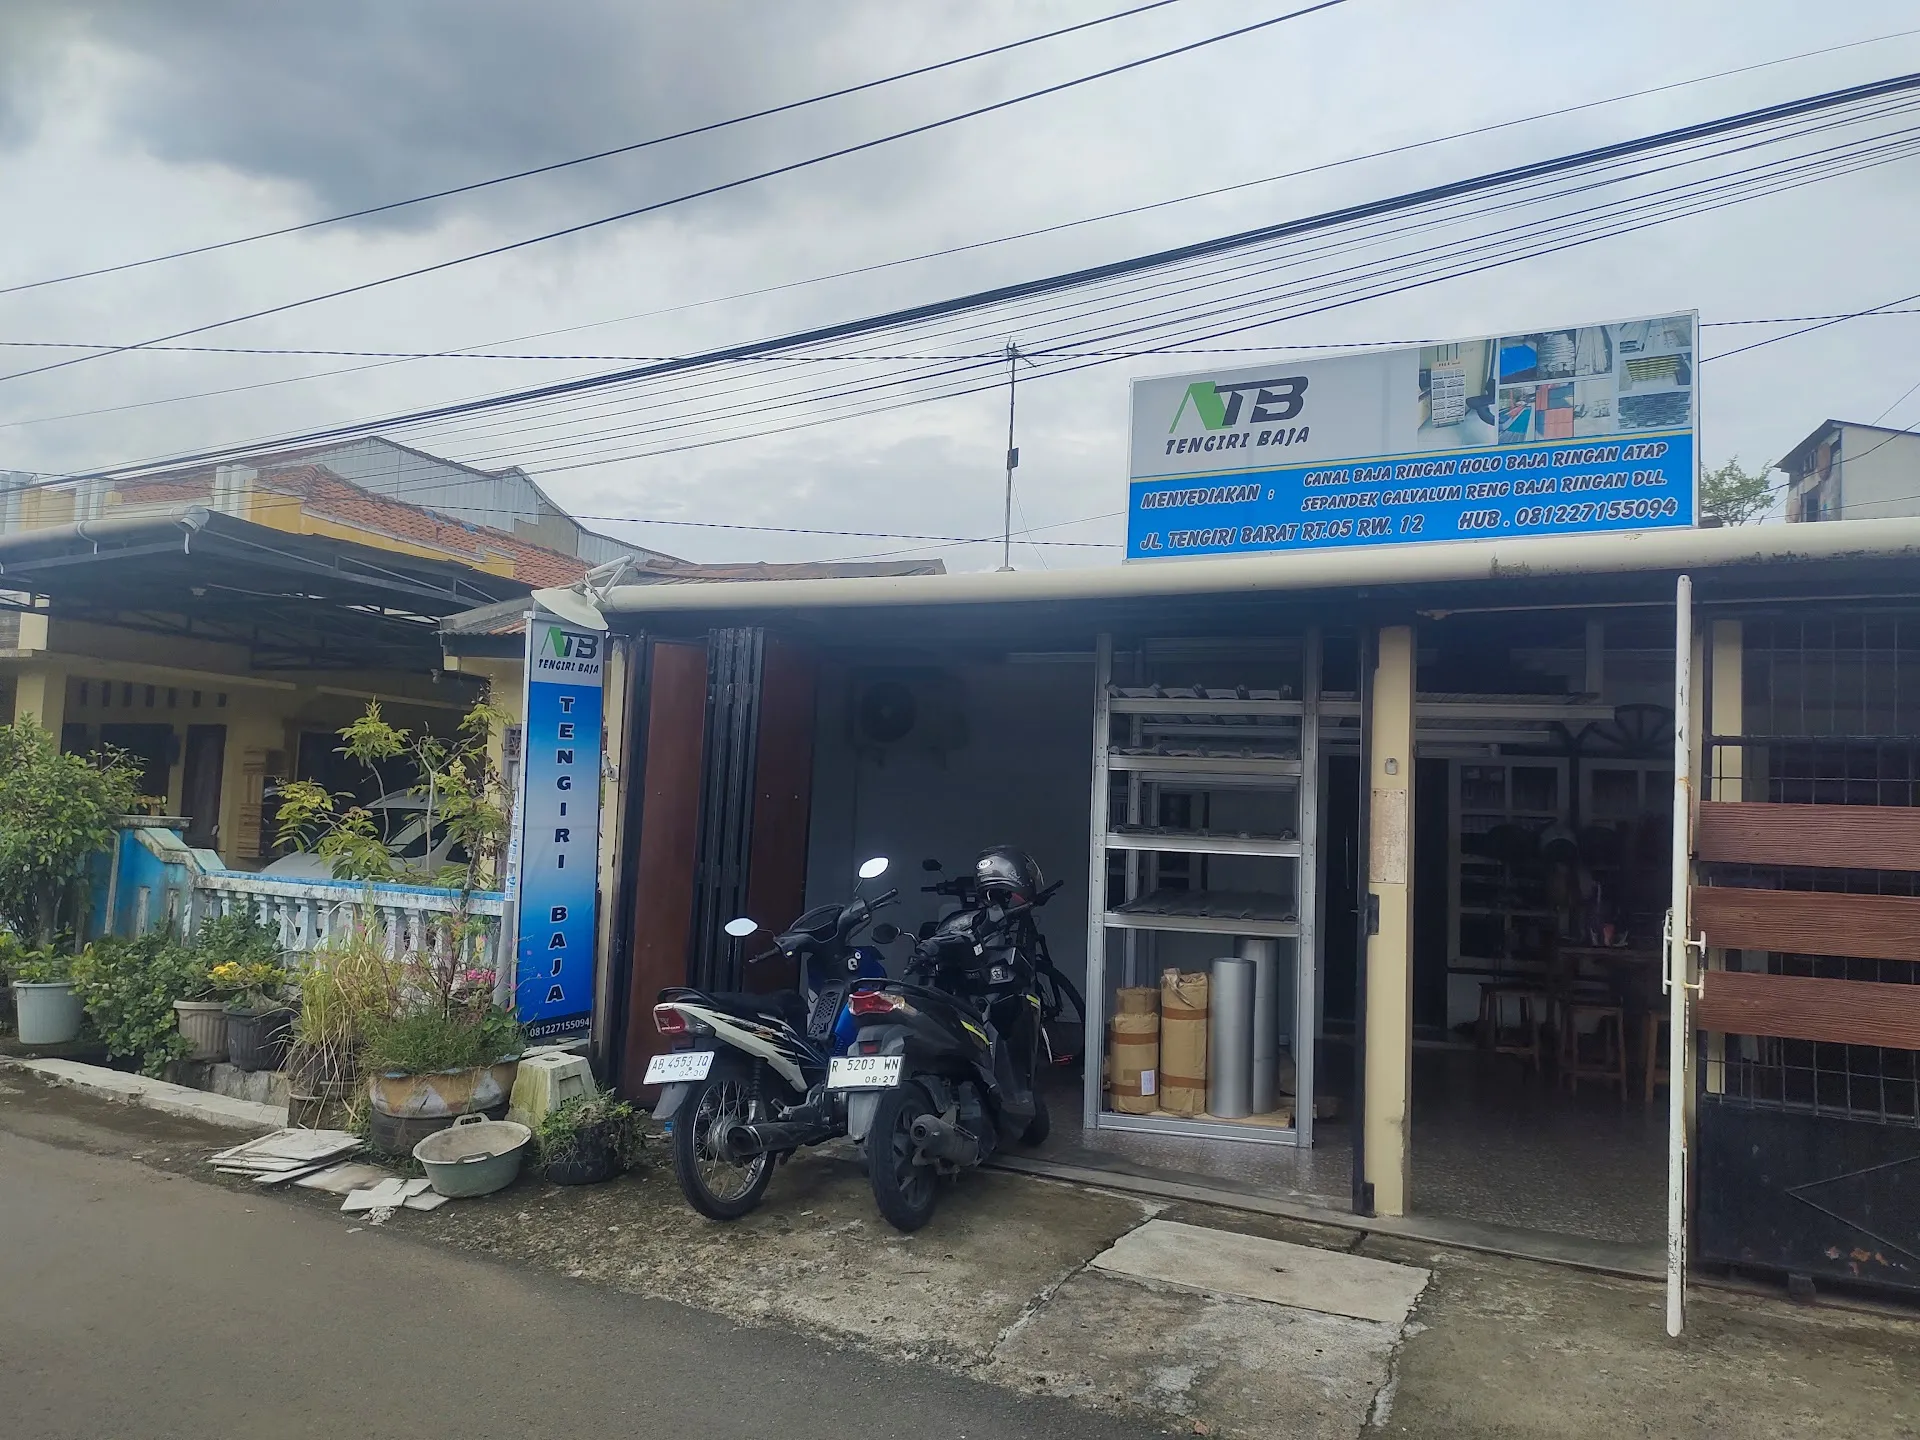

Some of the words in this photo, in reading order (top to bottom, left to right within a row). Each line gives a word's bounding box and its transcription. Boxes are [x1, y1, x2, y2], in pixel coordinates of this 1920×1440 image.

[1165, 432, 1250, 455] TENGIRI
[1256, 426, 1310, 447] BAJA
[1304, 469, 1349, 488] CANAL
[1354, 466, 1391, 484] BAJA
[1395, 460, 1456, 479] RINGAN
[1459, 457, 1501, 475] HOLO
[1506, 452, 1547, 470] BAJA
[1552, 446, 1620, 468] RINGAN
[1623, 442, 1667, 461] ATAP
[1140, 483, 1261, 510] MENYEDIAKAN
[1301, 491, 1378, 511] SEPANDEK
[1380, 485, 1462, 507] GALVALUM
[1466, 481, 1510, 500] RENG
[1514, 478, 1556, 496] BAJA
[1561, 472, 1628, 493] RINGAN
[1632, 468, 1667, 487] DLL.
[1515, 496, 1678, 527] 081227155094
[1140, 532, 1162, 550] JL.
[1168, 527, 1236, 549] TENGIRI
[1240, 522, 1300, 544] BARAT
[1301, 518, 1354, 541] RT.05
[1357, 515, 1392, 537] RW.
[1400, 514, 1424, 534] 12
[538, 659, 576, 672] TENGIRI
[578, 663, 599, 675] BAJA
[554, 696, 575, 869] TENGIRI
[545, 905, 568, 1004] BAJA
[529, 1017, 589, 1038] 081227155094
[651, 1058, 665, 1071] AB
[668, 1055, 693, 1068] 4553
[831, 1060, 839, 1073] R
[847, 1058, 876, 1071] 5203
[884, 1058, 899, 1070] WN
